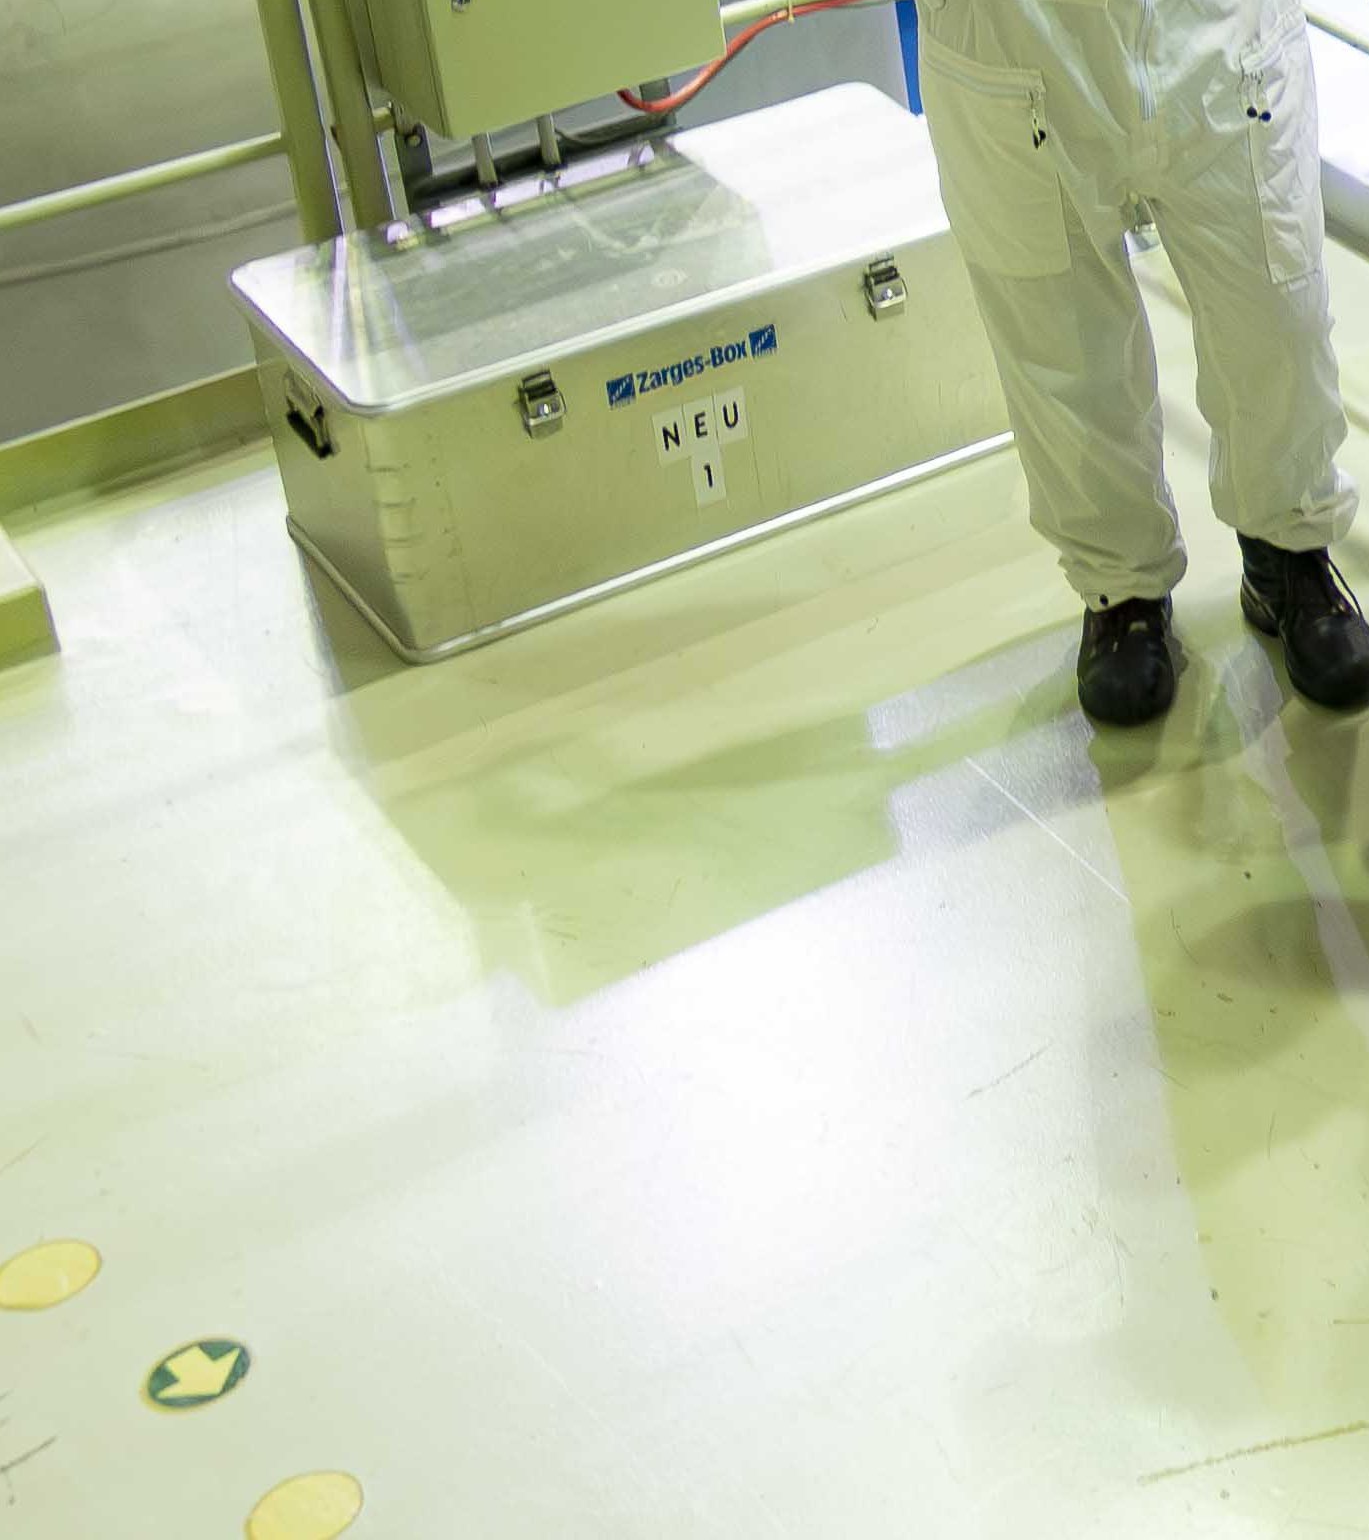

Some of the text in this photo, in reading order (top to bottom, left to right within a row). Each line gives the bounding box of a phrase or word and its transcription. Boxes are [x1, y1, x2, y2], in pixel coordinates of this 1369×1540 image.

[636, 340, 748, 394] Zarges-Box
[662, 401, 739, 450] NEU
[703, 462, 714, 488] 1
